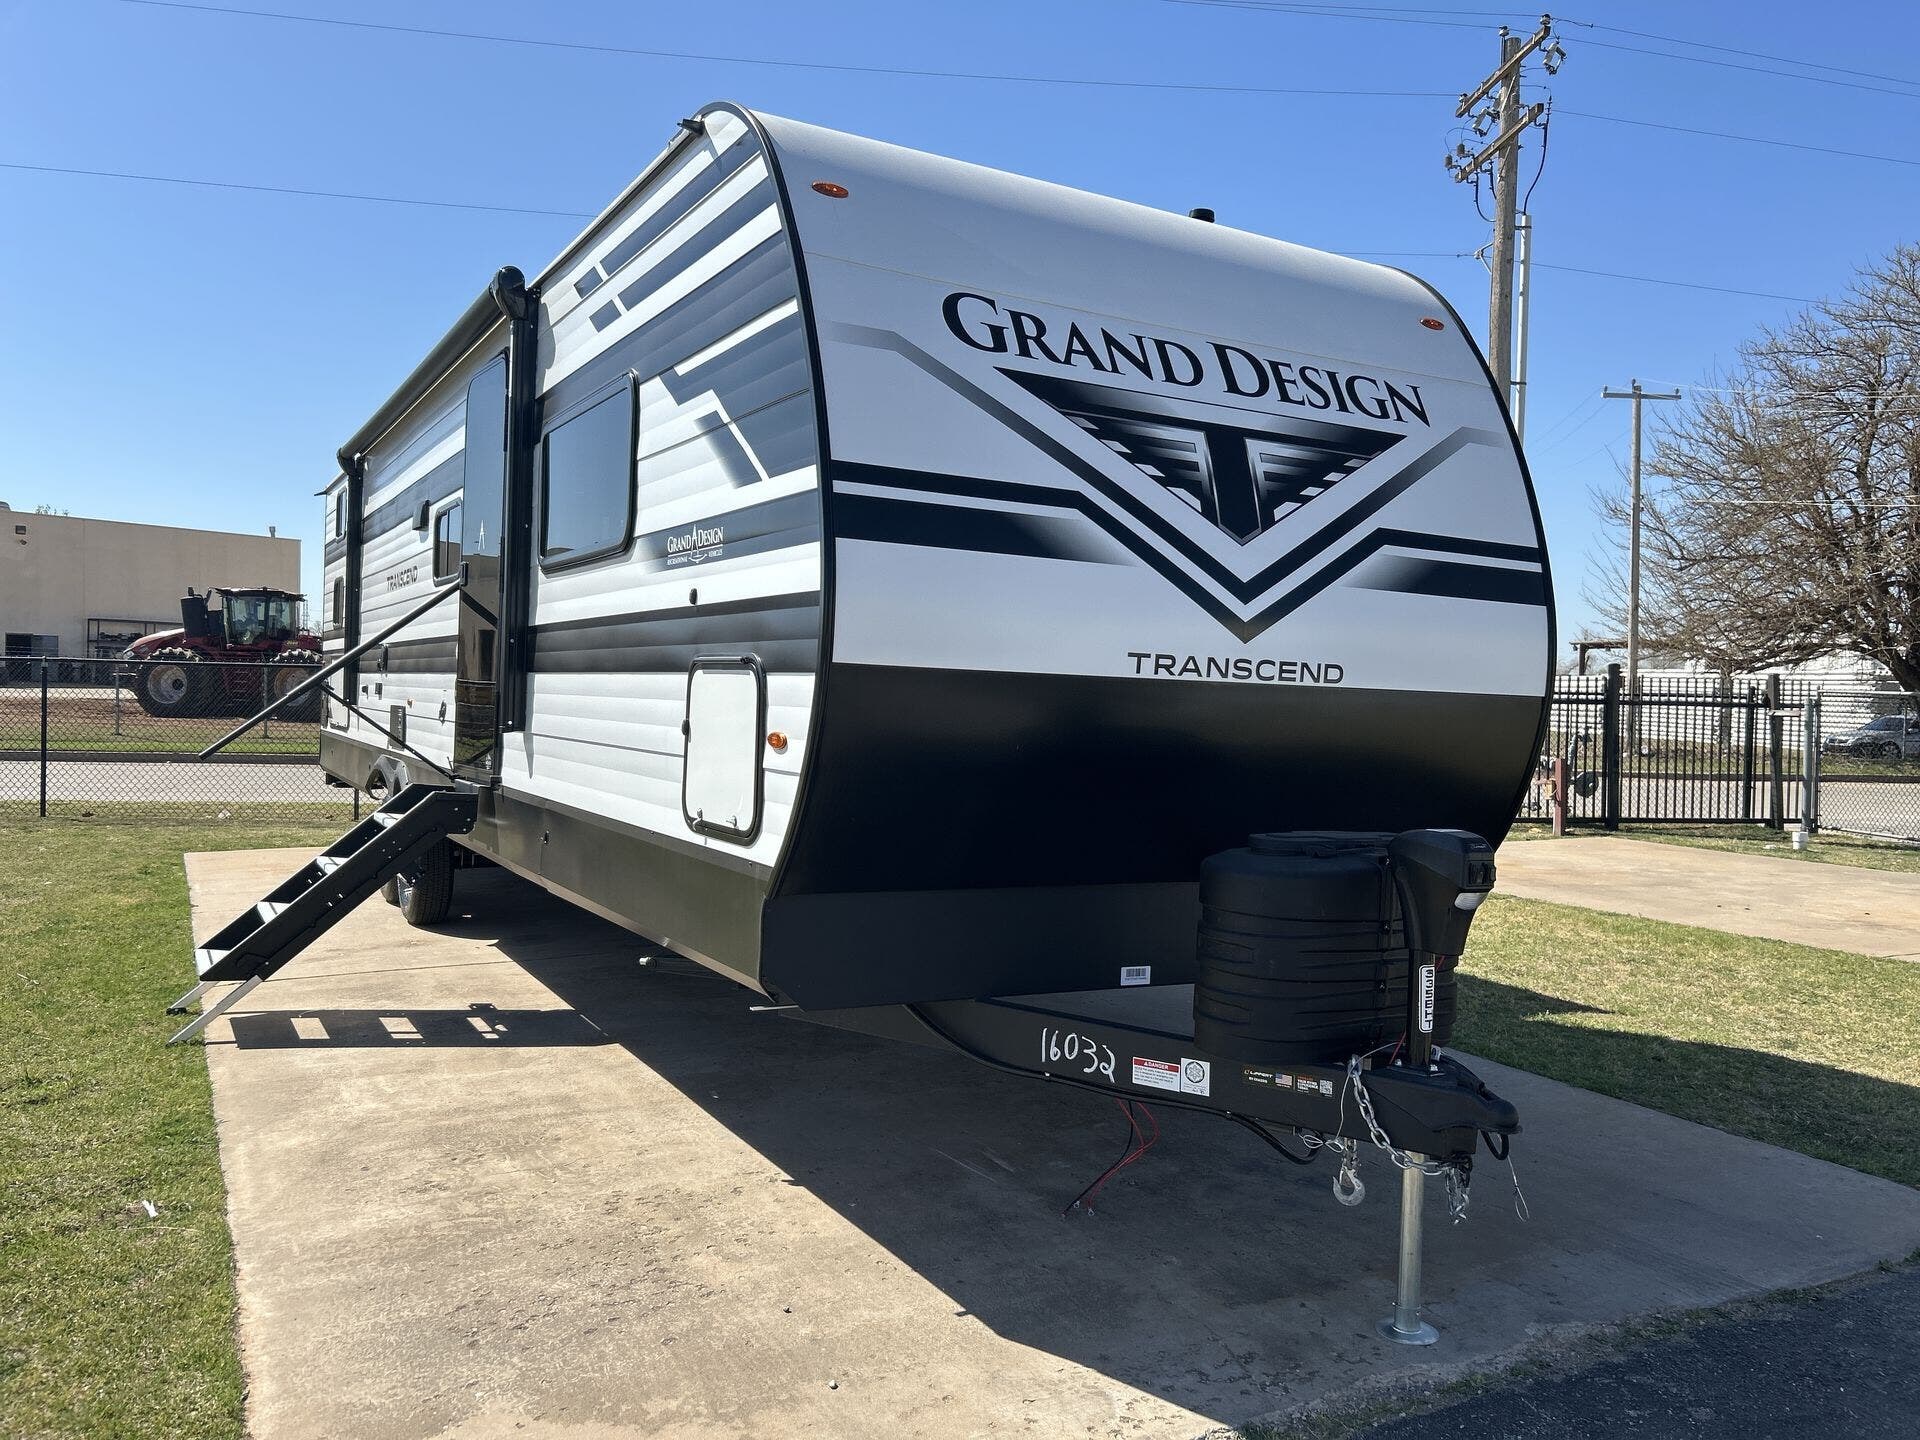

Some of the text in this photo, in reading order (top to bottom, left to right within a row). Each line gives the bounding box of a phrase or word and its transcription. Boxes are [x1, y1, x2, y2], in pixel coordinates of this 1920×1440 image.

[942, 292, 1431, 428] GRAND DESIGN
[667, 526, 724, 552] GRAND DESIGN
[387, 565, 418, 591] TRANSCEND
[1127, 652, 1345, 685] TRANSCEND
[1041, 1031, 1116, 1084] 16032
[1147, 1062, 1169, 1070] DANGER
